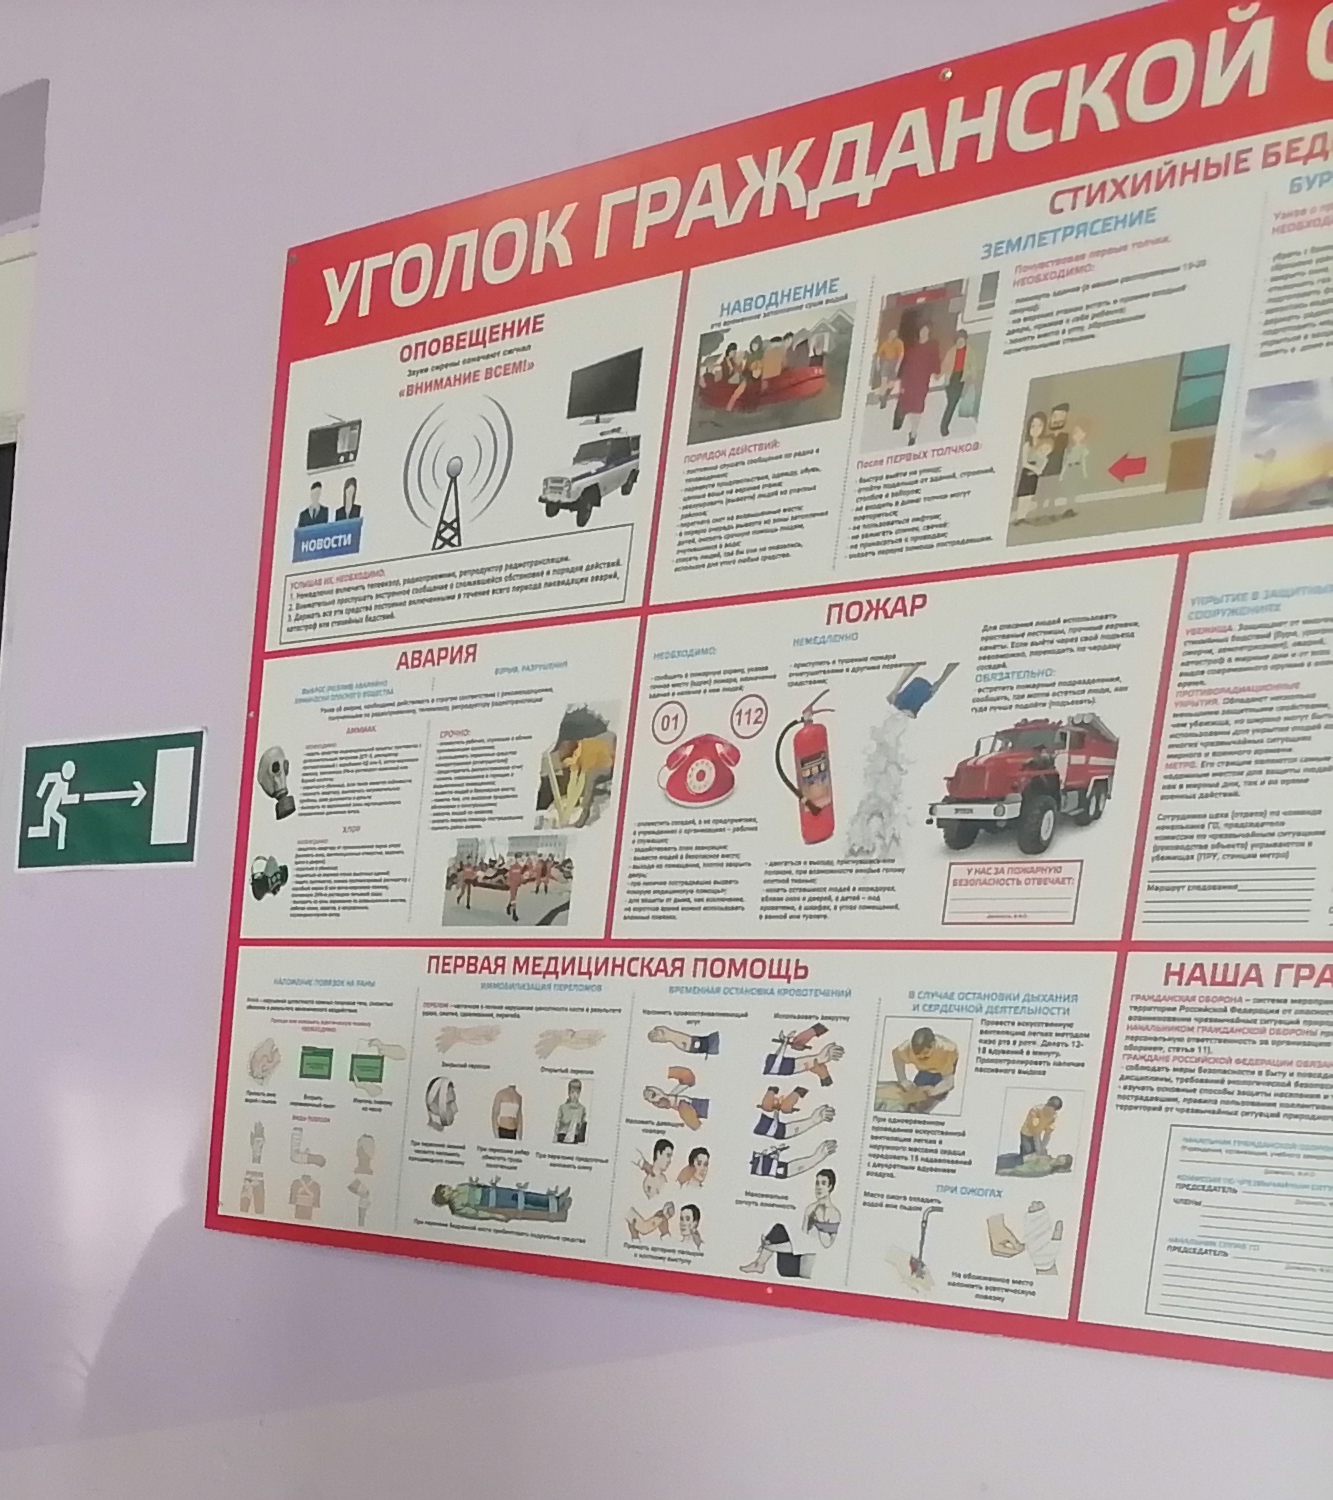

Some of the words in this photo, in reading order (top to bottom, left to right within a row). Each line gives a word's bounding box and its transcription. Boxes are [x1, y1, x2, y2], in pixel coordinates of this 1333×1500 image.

[322, 202, 578, 326] УГОЛОК
[594, 2, 1276, 260] ГРАЖДАНСКОЙ
[1048, 147, 1253, 215] СТИХИЙНЫЕ
[1261, 131, 1333, 169] БЕД
[981, 207, 1157, 260] ЗЕМЛЕТРЯСЕНИЕ
[719, 277, 839, 317] НАВОДНЕНИЕ
[400, 313, 545, 363] ОПОВЕЩЕНИЕ
[399, 371, 481, 398] «ВНИМАНИЕ
[485, 360, 534, 382] ВСЕМ!»
[302, 533, 351, 552] НОВОСТИ
[825, 594, 927, 626] ПОЖАР
[396, 643, 477, 670] АВАРИЯ
[661, 713, 679, 732] 01
[735, 707, 763, 726] 112
[427, 955, 506, 975] ПЕРВАЯ
[512, 955, 685, 980] МЕДИЦИНСКАЯ
[692, 957, 809, 984] ПОМОЩЬ
[1164, 962, 1263, 988] НАША
[923, 1002, 983, 1014] СЕРДЕЧНОЙ
[985, 1006, 1070, 1016] ДЕЯТЕЛЬНОСТИ
[960, 1187, 1003, 1198] ОЖОГАХ
